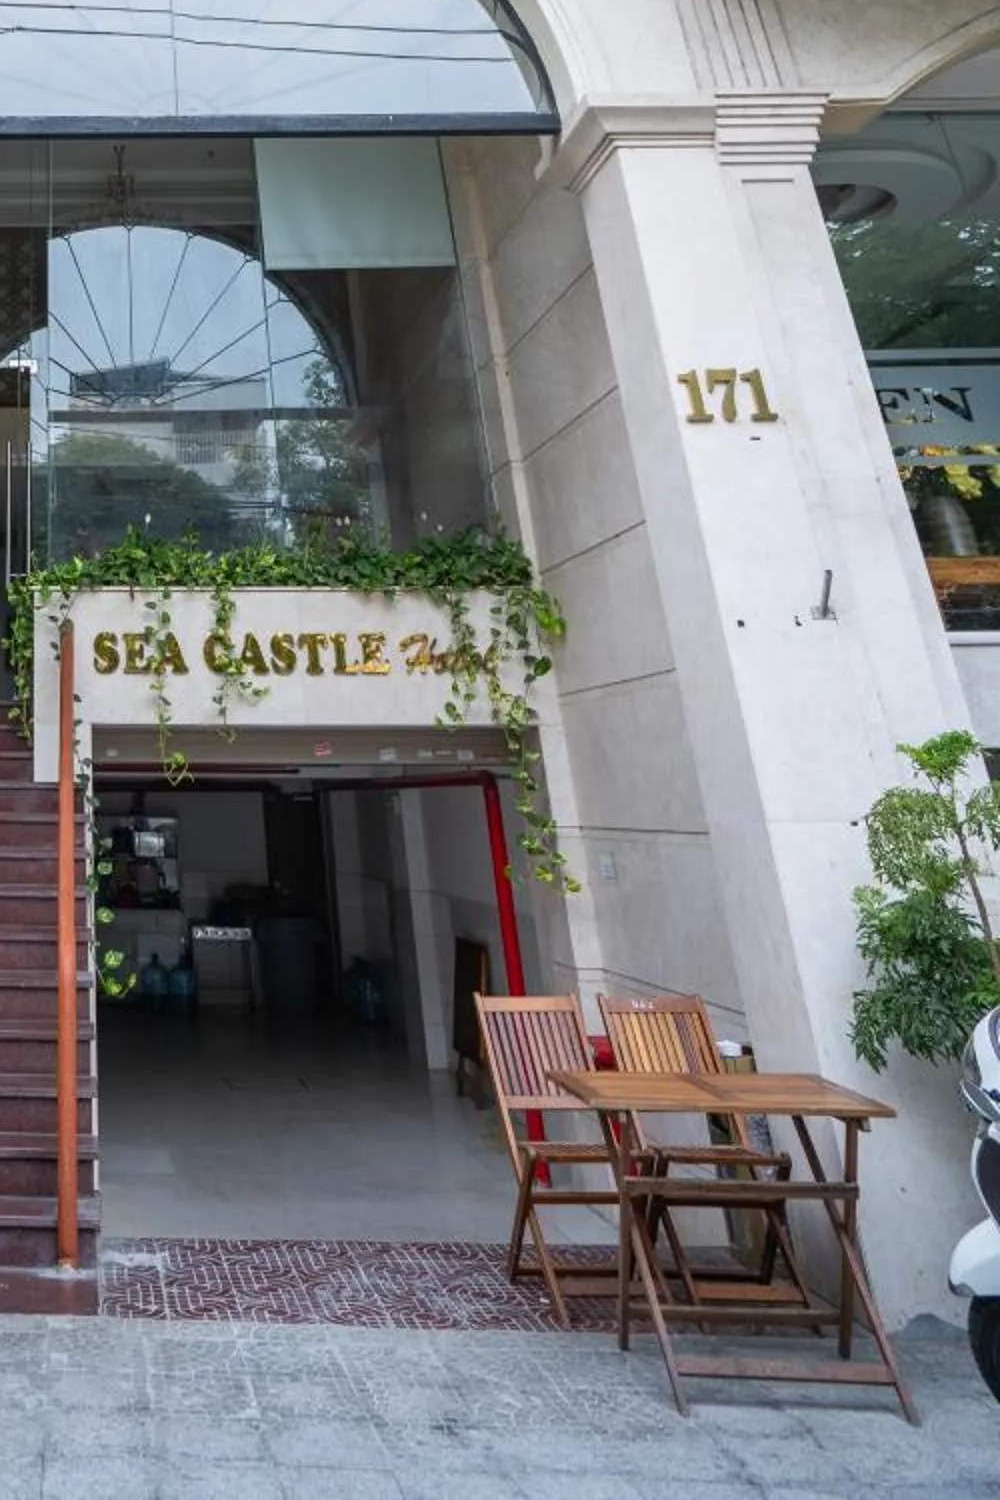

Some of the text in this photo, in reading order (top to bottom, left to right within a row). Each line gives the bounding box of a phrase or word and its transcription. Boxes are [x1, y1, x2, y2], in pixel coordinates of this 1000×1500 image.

[676, 368, 779, 424] 171
[93, 630, 500, 676] SEA CASTLE Hol
